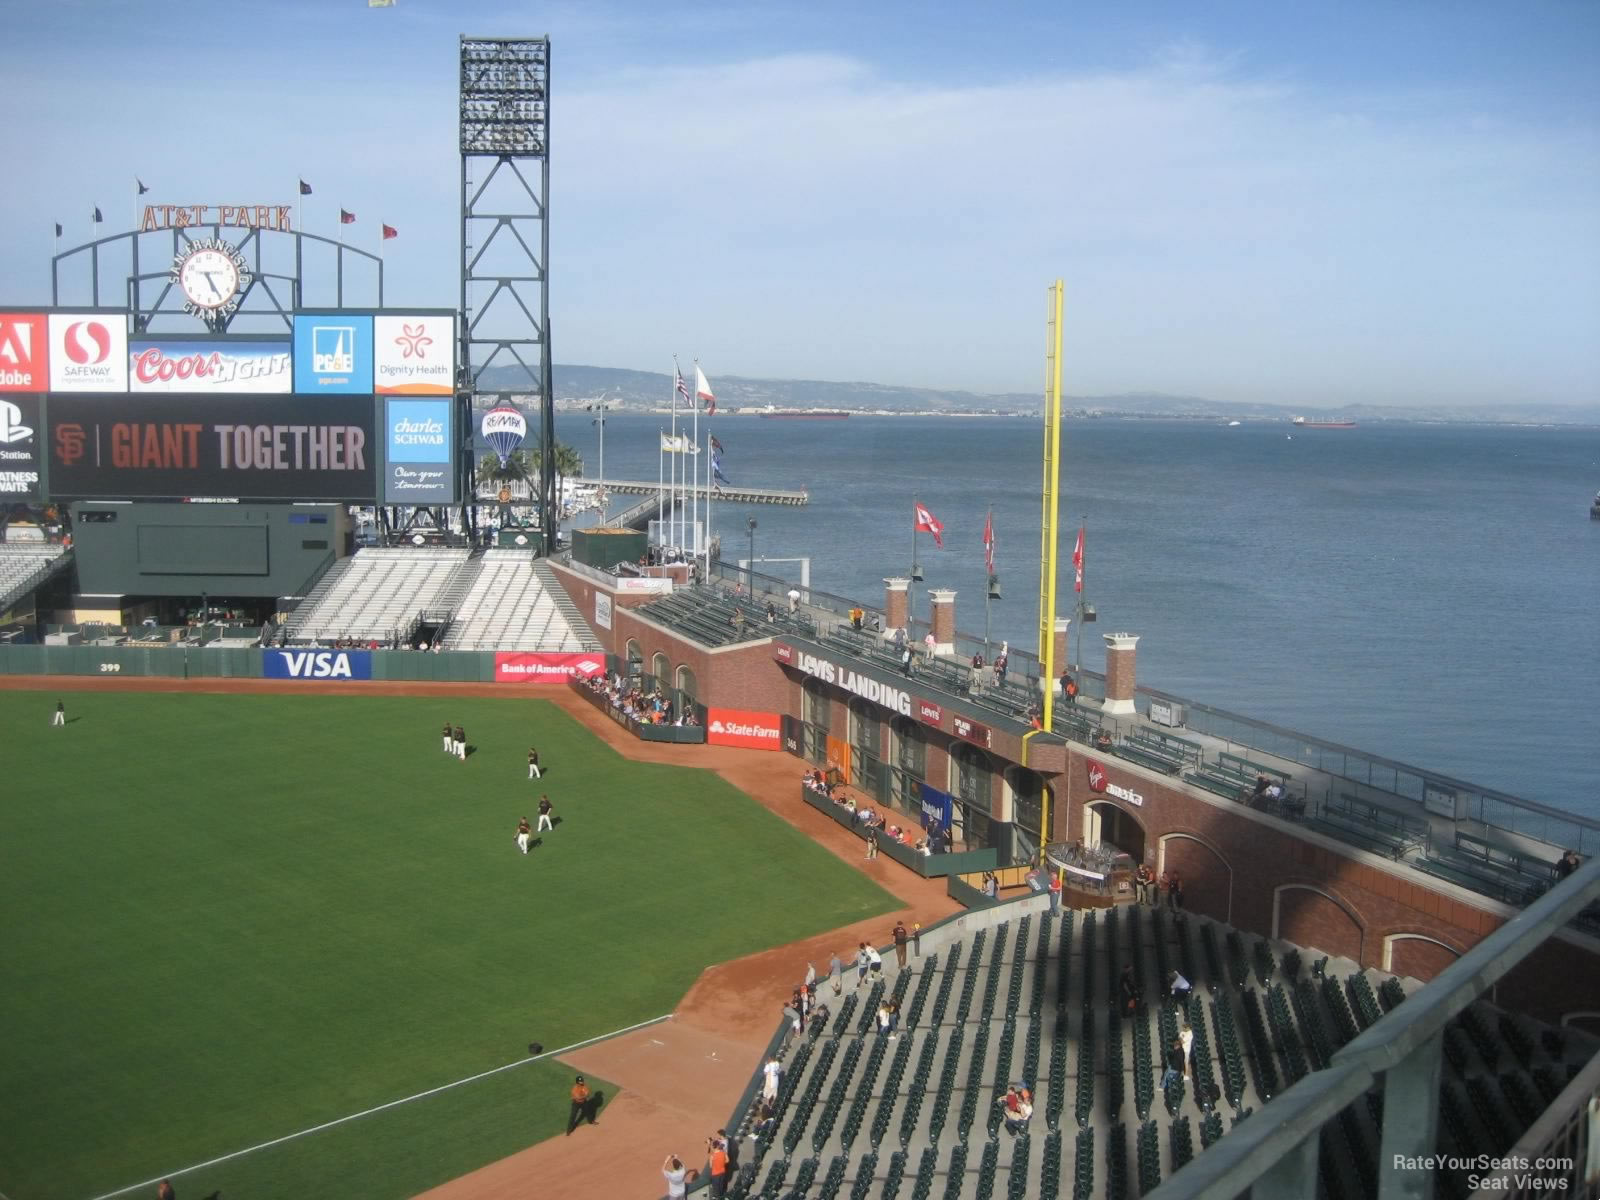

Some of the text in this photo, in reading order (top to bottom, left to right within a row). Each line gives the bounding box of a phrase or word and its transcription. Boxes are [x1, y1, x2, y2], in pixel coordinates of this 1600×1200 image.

[141, 205, 291, 233] AT&T PARK
[183, 300, 237, 320] GIANTS
[134, 347, 220, 383] Coors
[316, 354, 351, 371] PG&E
[0, 369, 31, 385] dobe
[65, 366, 110, 376] SAFEWAY
[380, 365, 448, 377] Dignity Health
[394, 417, 443, 433] charles
[487, 414, 521, 428] RE/MAX
[112, 424, 366, 470] GIANT TOGETHER
[394, 434, 443, 444] SCHWAB
[0, 472, 38, 482] ATNESS
[395, 467, 443, 482] Own your
[100, 663, 120, 673] 399
[279, 652, 352, 678] VISA
[502, 663, 575, 674] Bank of America
[838, 667, 911, 717] LANDING
[725, 722, 779, 739] State Farm
[787, 738, 797, 750] 365
